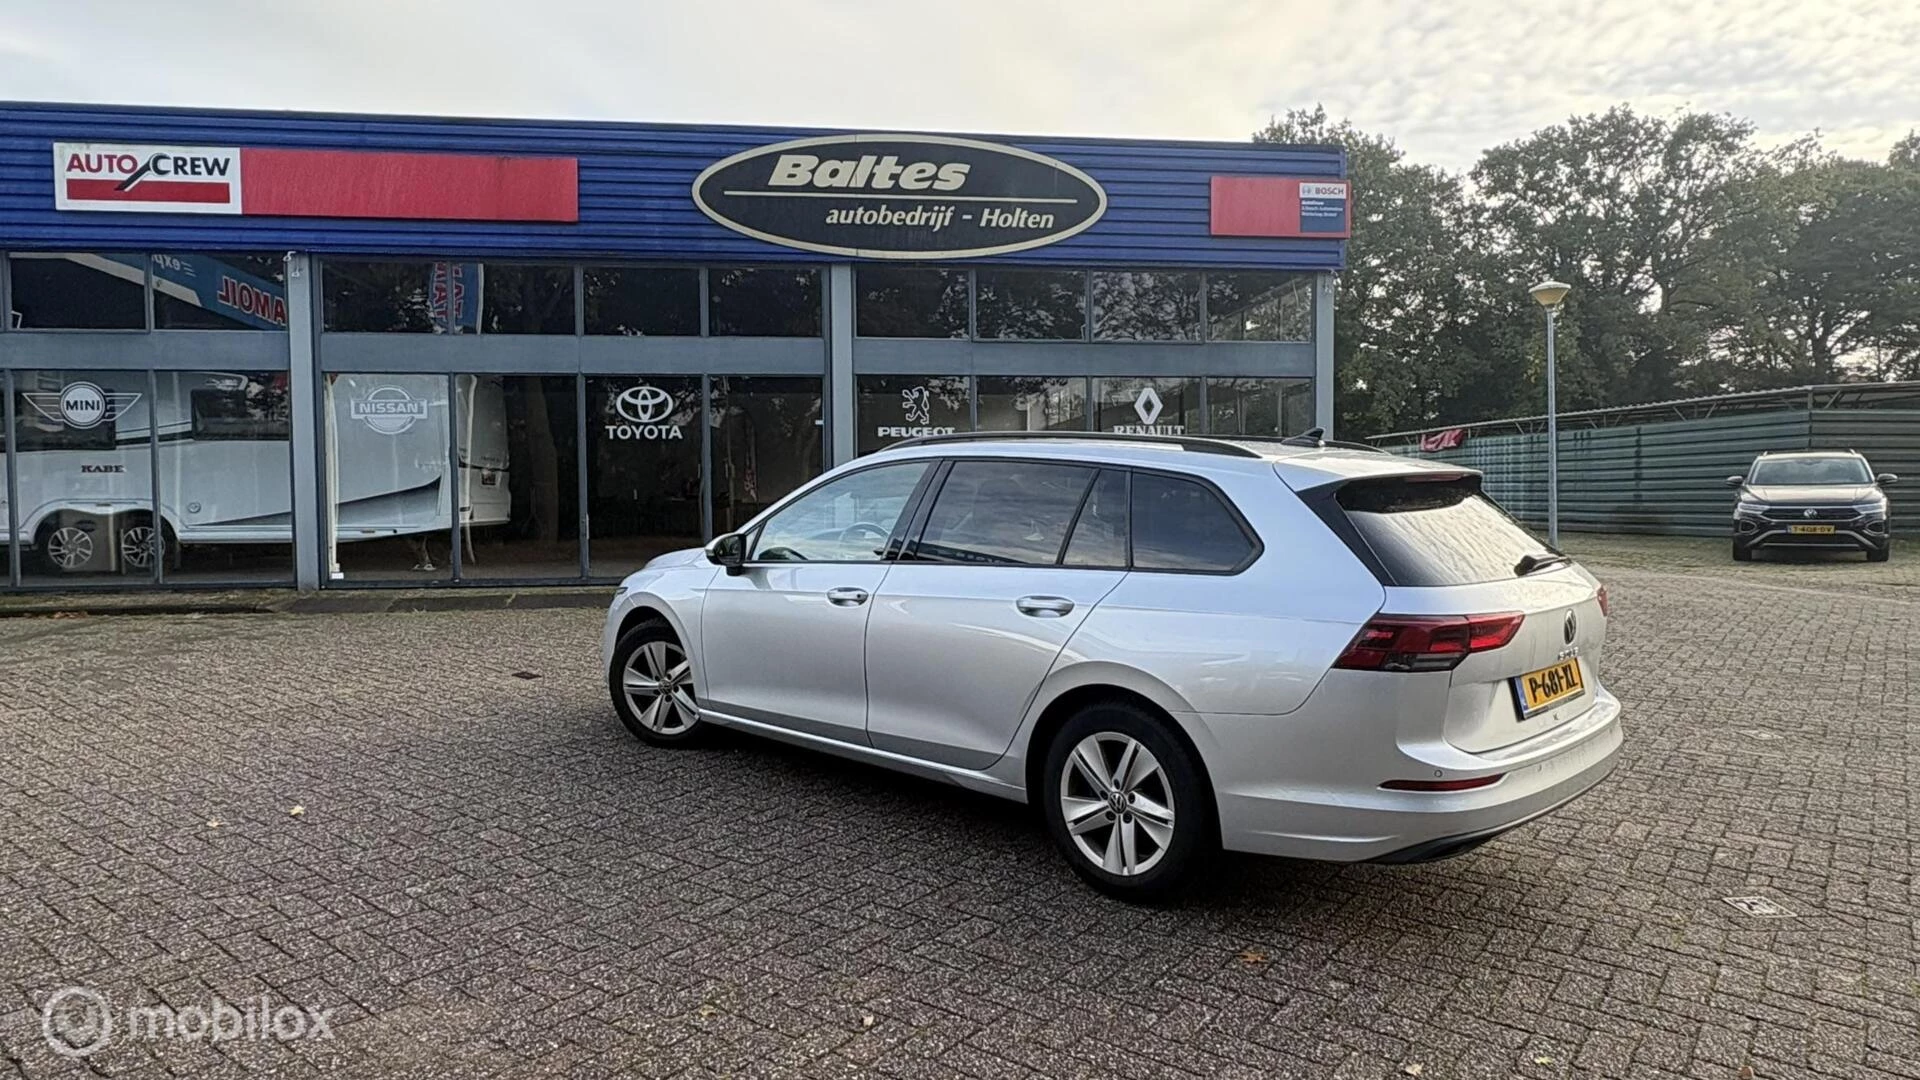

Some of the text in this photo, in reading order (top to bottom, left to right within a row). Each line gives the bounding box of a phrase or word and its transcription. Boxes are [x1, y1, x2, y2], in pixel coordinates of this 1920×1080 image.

[66, 153, 231, 177] AUTO CREW
[768, 154, 971, 191] Baltes
[1315, 187, 1344, 195] BOSCH
[825, 206, 955, 232] autobedrijf
[979, 208, 1055, 229] Holten
[65, 400, 100, 411] MINI
[359, 403, 418, 413] NISSAN
[604, 425, 683, 440] TOYOTA
[877, 427, 956, 437] PEUGEOT
[1113, 425, 1184, 436] RENAULT
[81, 464, 125, 473] KABE
[1528, 663, 1579, 703] P-681-XL
